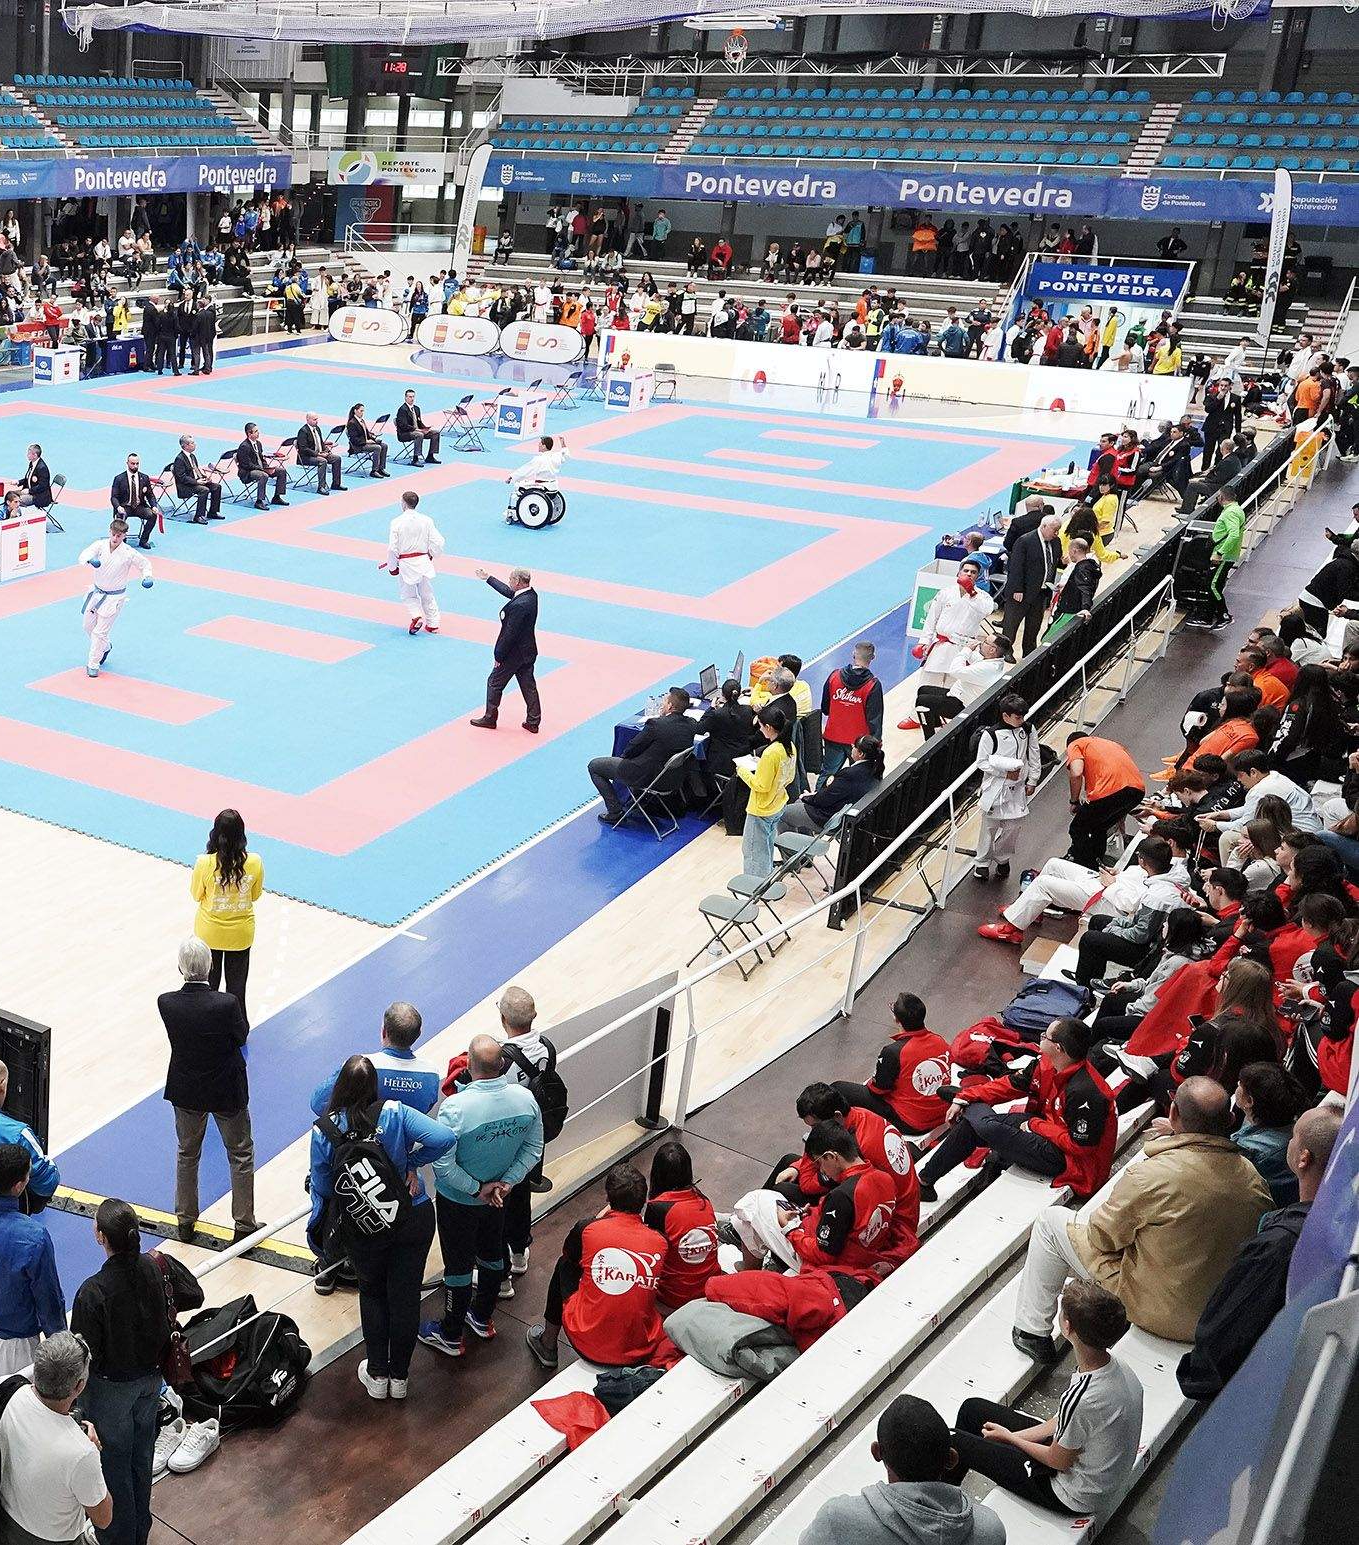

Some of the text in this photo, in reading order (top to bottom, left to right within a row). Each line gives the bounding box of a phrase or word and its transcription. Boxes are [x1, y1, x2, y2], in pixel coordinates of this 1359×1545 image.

[384, 62, 407, 73] 11:28
[74, 164, 167, 191] Pontevedra
[199, 162, 277, 186] Pontevedra
[686, 172, 836, 199] Pontevedra
[898, 179, 1073, 207] Pontevedra
[1171, 200, 1206, 208] Pontevedra
[1062, 270, 1155, 285] DEPORTE
[1038, 280, 1174, 298] PONTEVEDRA
[610, 392, 631, 402] Daedo
[500, 418, 521, 429] Daedo
[384, 1077, 423, 1090] HELENOS
[350, 1157, 400, 1223] FILA
[604, 1267, 660, 1287] KARATE
[763, 1477, 773, 1493] 79
[470, 1510, 481, 1524] 79
